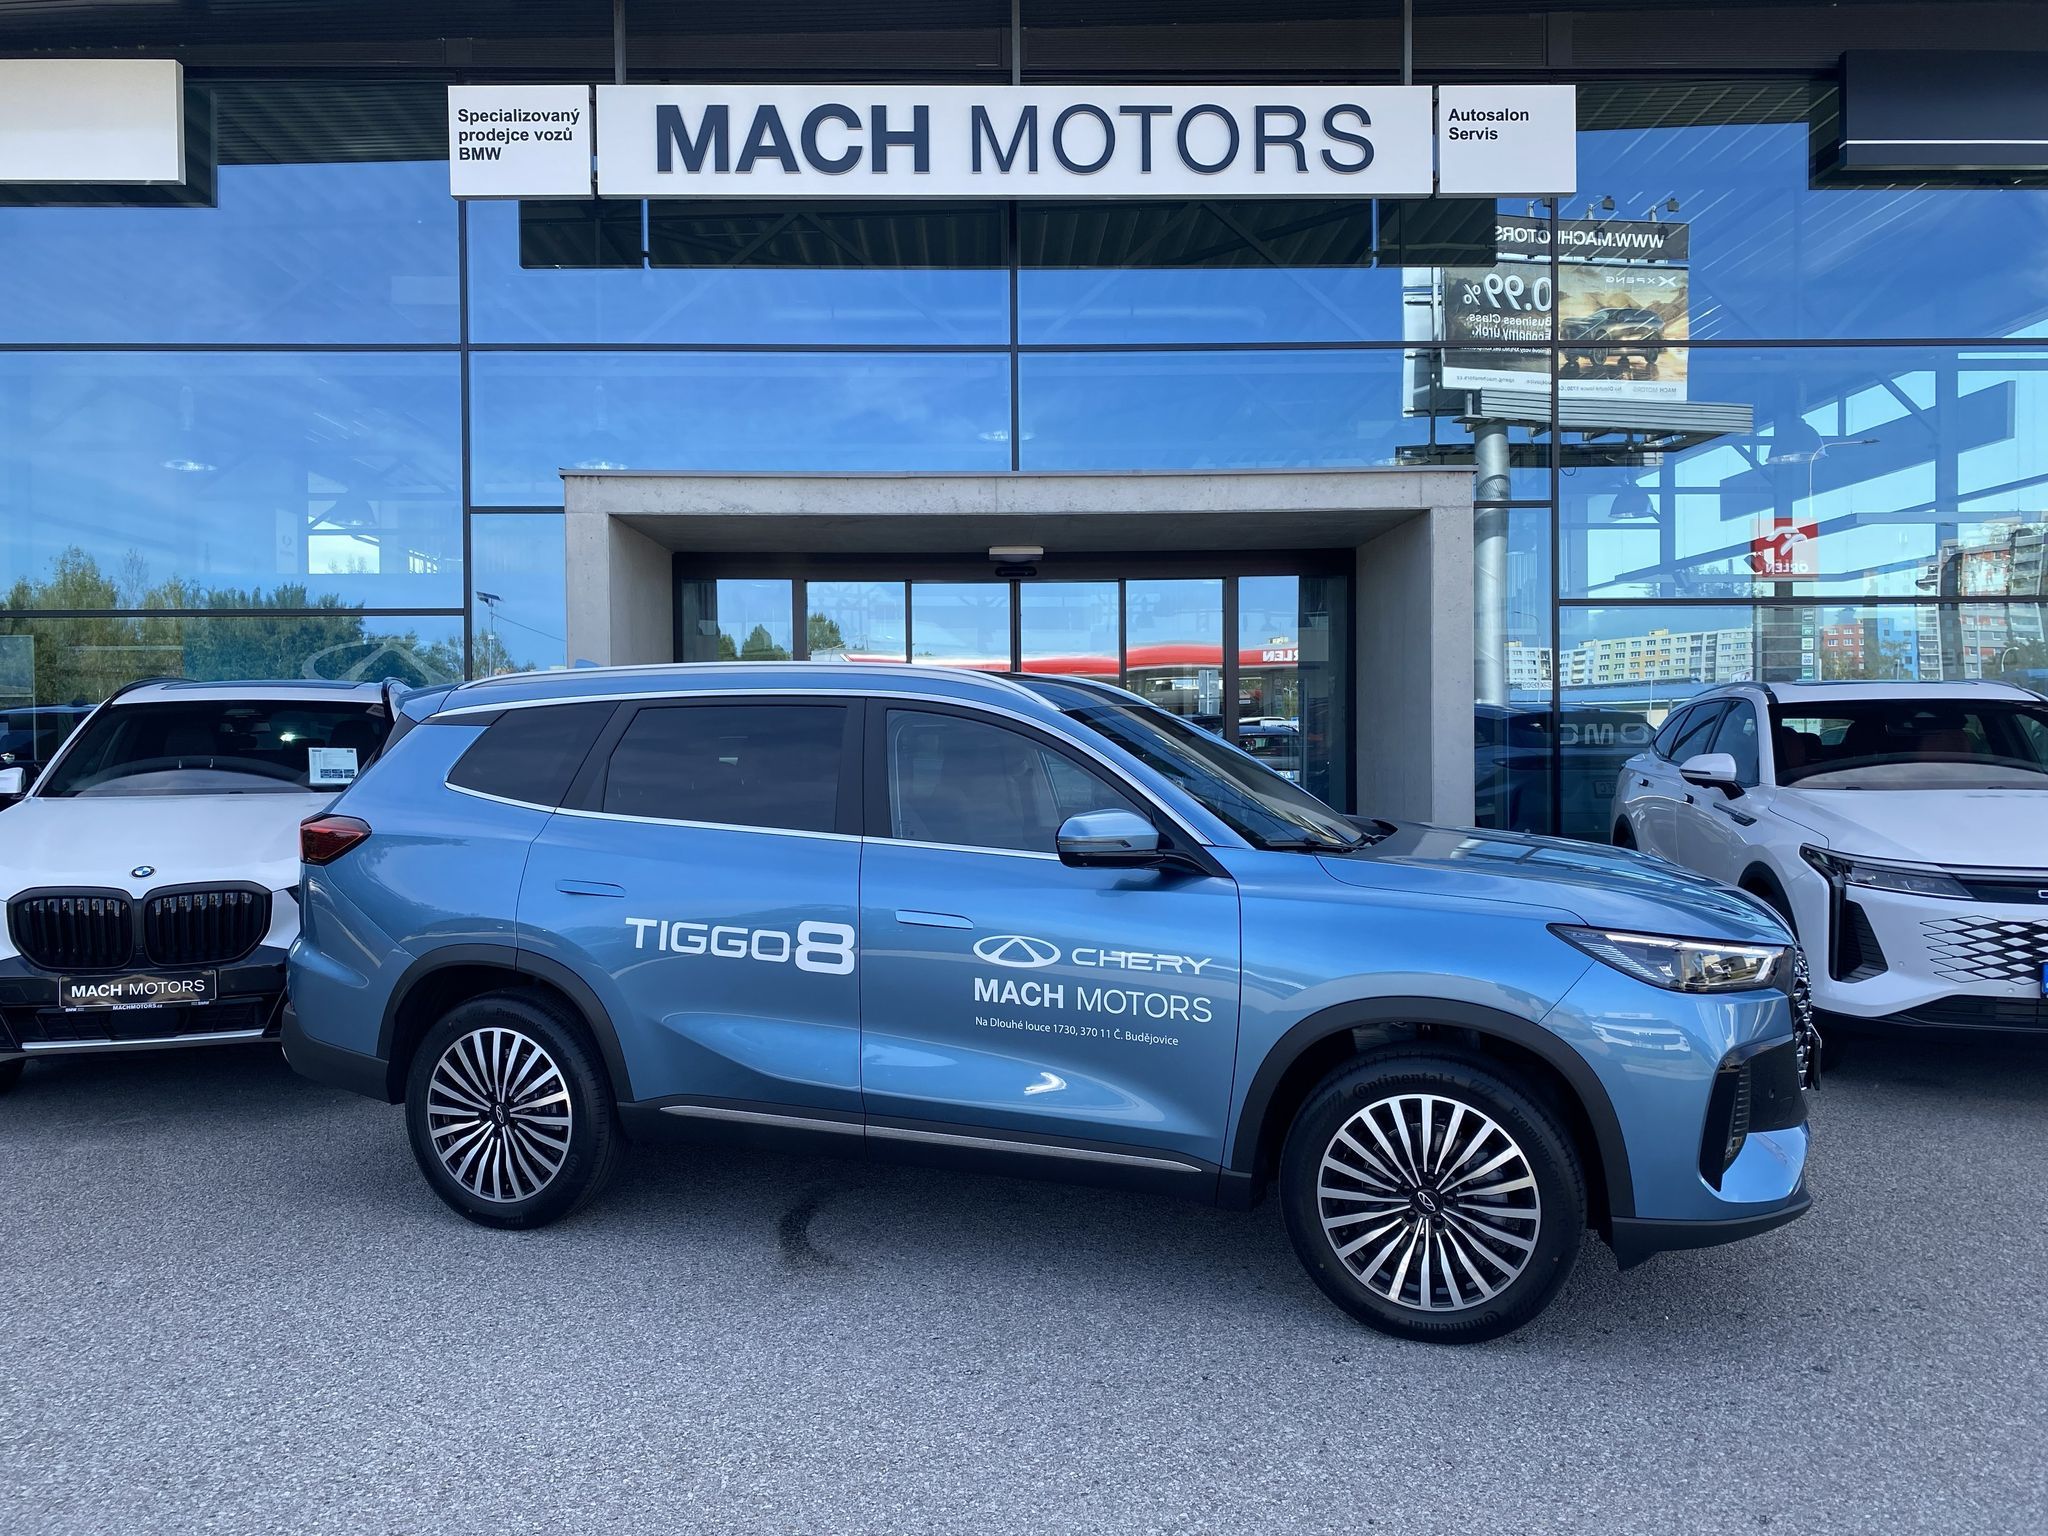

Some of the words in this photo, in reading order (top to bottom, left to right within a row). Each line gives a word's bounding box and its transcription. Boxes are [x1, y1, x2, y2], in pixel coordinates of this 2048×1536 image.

[458, 108, 580, 125] Specializovaný
[1448, 108, 1530, 122] Autosalon
[459, 128, 529, 144] prodejce
[534, 127, 573, 141] vozů
[656, 103, 931, 175] MACH
[971, 103, 1375, 175] MOTORS
[1448, 127, 1498, 141] Servis
[459, 147, 502, 160] BMW
[1071, 948, 1213, 975] CHERY
[71, 983, 122, 998] MACH
[129, 979, 205, 996] MOTORS
[974, 977, 1064, 1009] MACH
[1077, 986, 1213, 1023] MOTORS
[975, 1016, 988, 1027] Na
[990, 1017, 1024, 1030] Dlouhé
[1025, 1020, 1051, 1033] louce
[1053, 1024, 1078, 1036] 1730,
[1080, 1026, 1098, 1038] 370
[1101, 1028, 1111, 1039] 11
[1113, 1027, 1123, 1040] Č.
[1126, 1031, 1179, 1047] Budějovice
[1352, 1071, 1446, 1097] Continental
